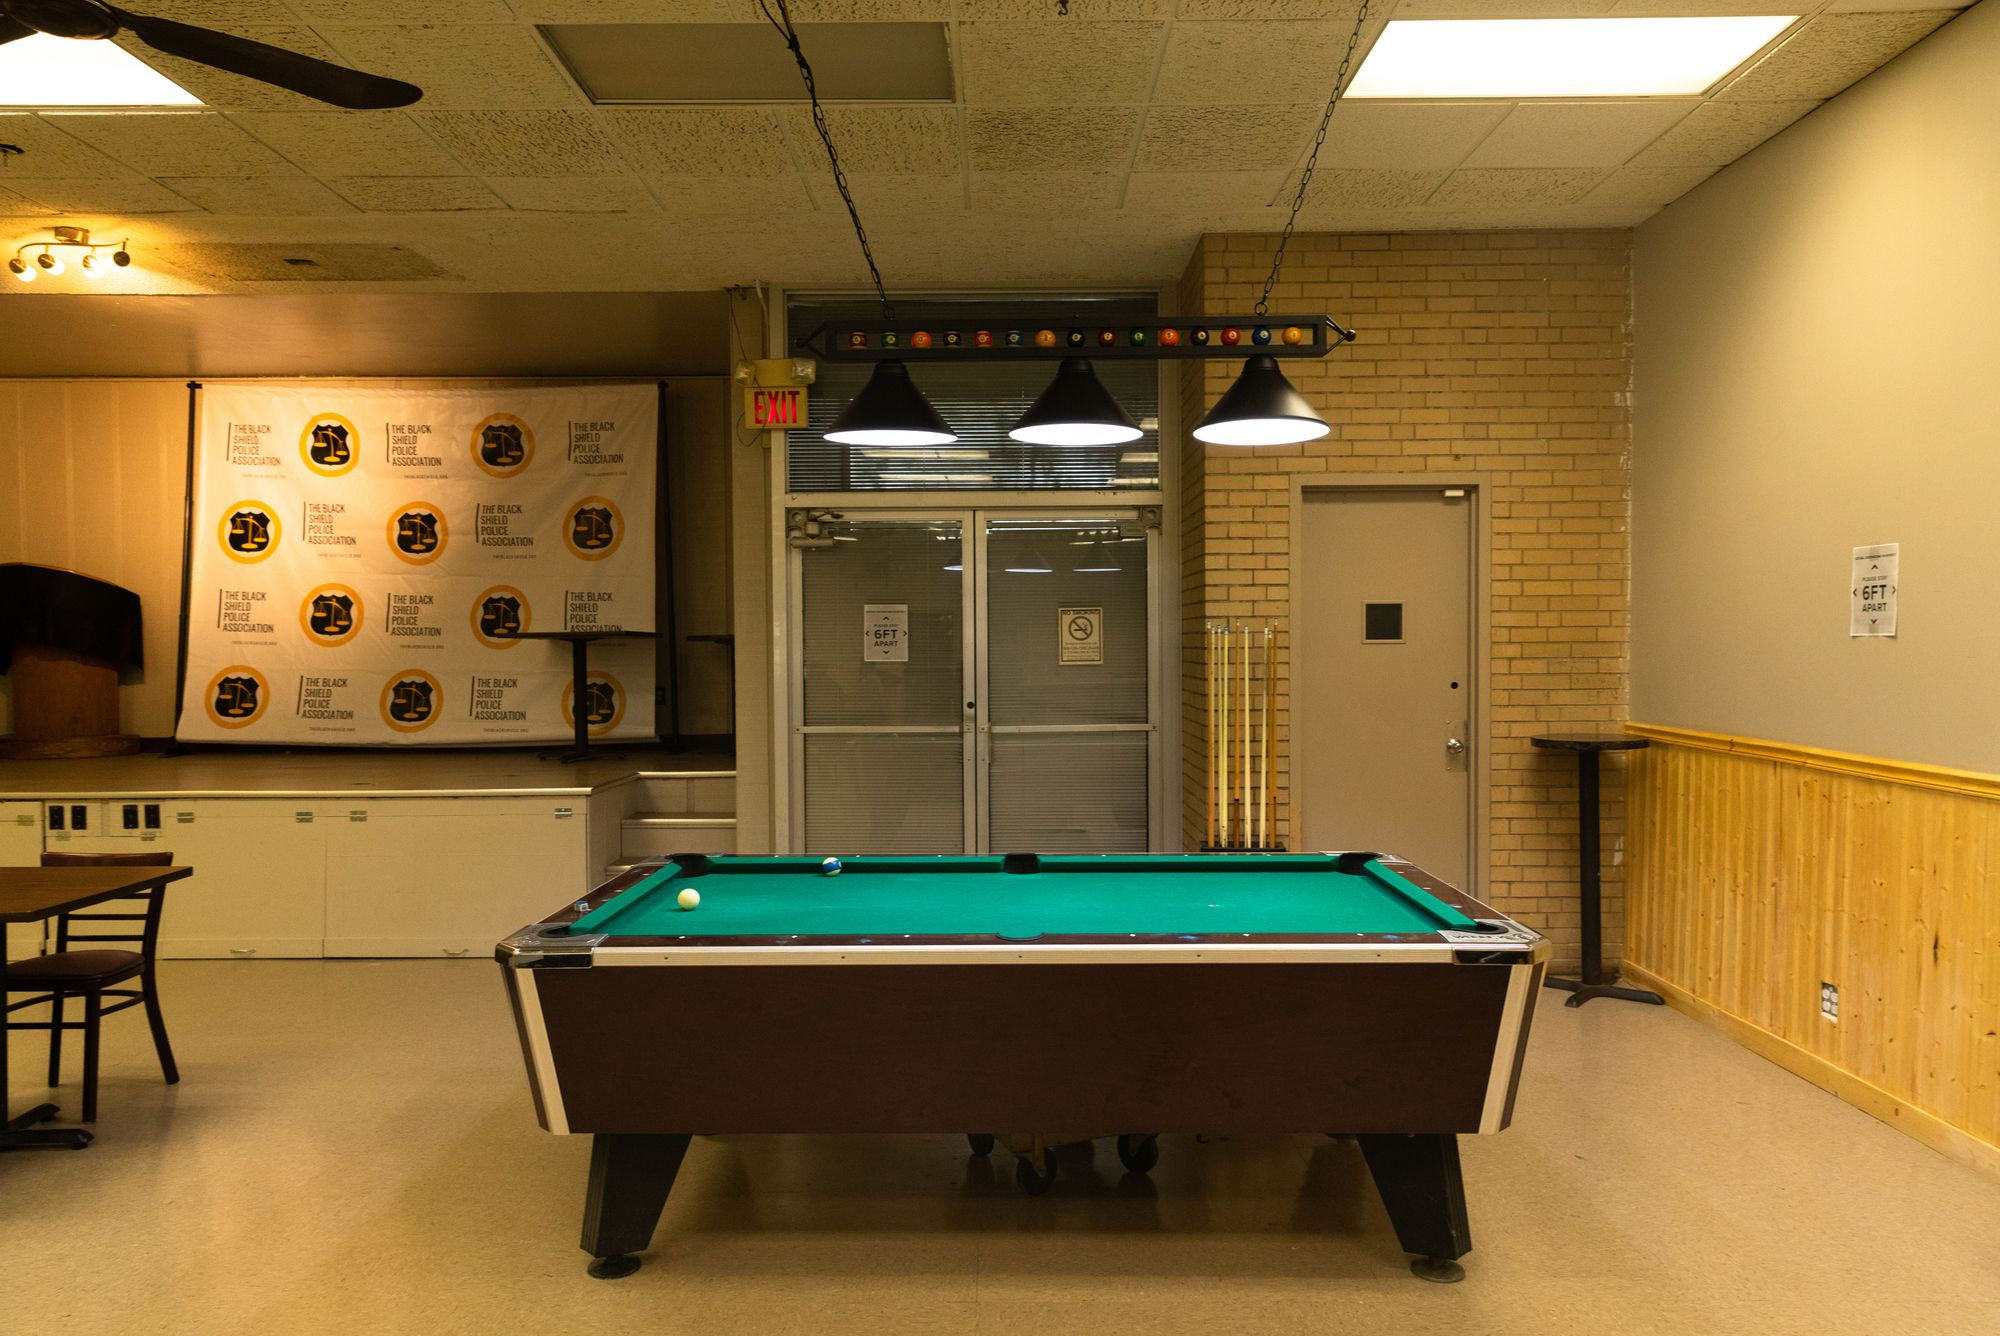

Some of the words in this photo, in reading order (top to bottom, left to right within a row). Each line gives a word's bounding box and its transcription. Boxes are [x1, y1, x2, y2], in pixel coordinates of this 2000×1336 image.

[754, 391, 800, 424] EXIT
[234, 425, 247, 433] THE
[248, 425, 271, 433] BLACK
[392, 425, 406, 434] THE
[408, 425, 432, 434] BLACK
[574, 423, 588, 432] THE
[590, 422, 615, 431] BLACK
[233, 436, 259, 444] SHIELD
[392, 436, 417, 444] SHIELD
[574, 434, 600, 442] SHIELD
[233, 446, 259, 455] POLICE
[392, 446, 417, 455] POLICE
[574, 444, 600, 453] POLICE
[231, 457, 281, 466] ASSOCIATION
[392, 457, 441, 466] ASSOCIATION
[573, 454, 624, 464] ASSOCIATION
[309, 504, 321, 512] THE
[323, 504, 345, 512] BLACK
[482, 505, 496, 514] THE
[498, 505, 522, 514] BLACK
[309, 515, 333, 523] SHIELD
[481, 516, 507, 525] SHIELD
[308, 525, 334, 534] POLICE
[481, 527, 508, 535] POLICE
[308, 536, 356, 545] ASSOCIATION
[482, 537, 533, 546] ASSOCIATION
[225, 591, 239, 600] THE
[242, 592, 266, 600] BLACK
[570, 592, 585, 601] THE
[588, 592, 613, 601] BLACK
[1862, 584, 1887, 600] 6FT
[393, 595, 407, 604] THE
[409, 595, 433, 604] BLACK
[224, 602, 251, 611] SHIELD
[392, 606, 418, 614] SHIELD
[570, 603, 598, 612] SHIELD
[1862, 603, 1887, 612] APART
[224, 613, 250, 621] POLICE
[392, 617, 418, 625] POLICE
[570, 614, 597, 623] POLICE
[223, 623, 274, 633] ASSOCIATION
[391, 627, 441, 637] ASSOCIATION
[874, 629, 898, 639] 6FT
[306, 678, 319, 687] THE
[322, 678, 348, 688] BLACK
[477, 679, 491, 688] THE
[493, 679, 517, 688] BLACK
[304, 689, 331, 697] SHIELD
[477, 690, 503, 698] SHIELD
[303, 699, 329, 708] POLICE
[476, 700, 501, 709] POLICE
[301, 710, 353, 719] ASSOCIATION
[475, 711, 526, 720] ASSOCIATION
